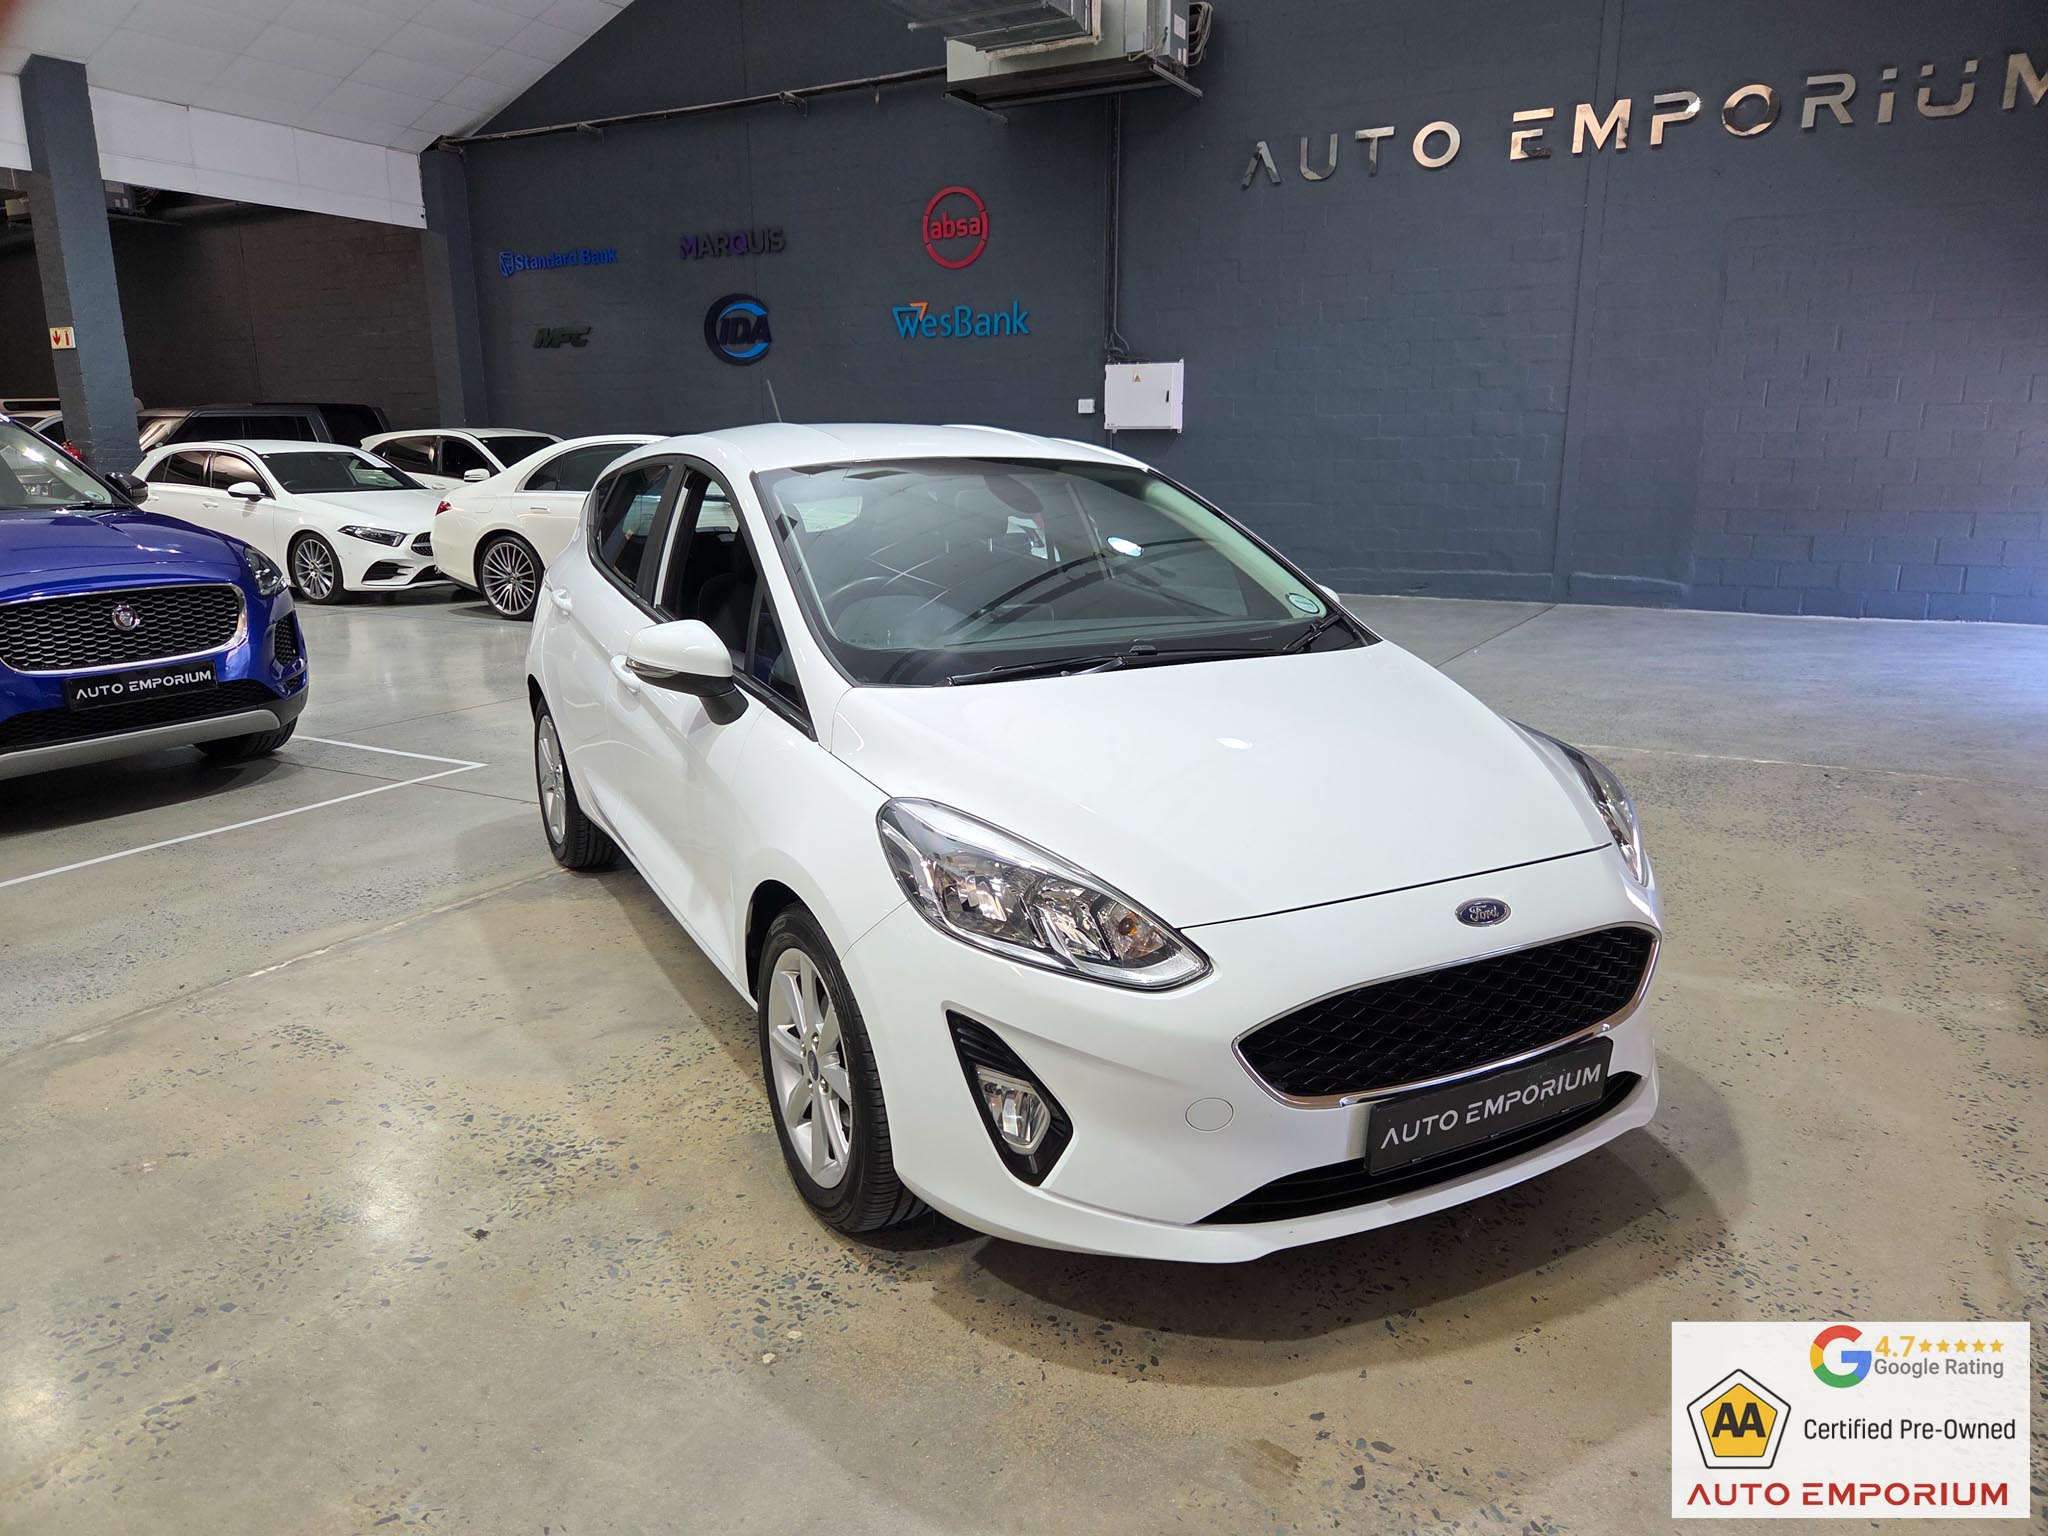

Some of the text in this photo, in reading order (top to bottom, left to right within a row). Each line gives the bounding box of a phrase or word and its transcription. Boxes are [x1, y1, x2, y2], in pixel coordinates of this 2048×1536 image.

[1240, 121, 1462, 190] AUTO
[930, 212, 982, 240] absa
[514, 247, 618, 271] Standard Bank
[680, 227, 786, 260] MARQUIS
[892, 300, 1030, 338] WesBank
[76, 670, 212, 700] AUTO EMPORIUM
[1468, 904, 1499, 921] Ford
[1381, 1064, 1602, 1149] AUTO EMPORIUM
